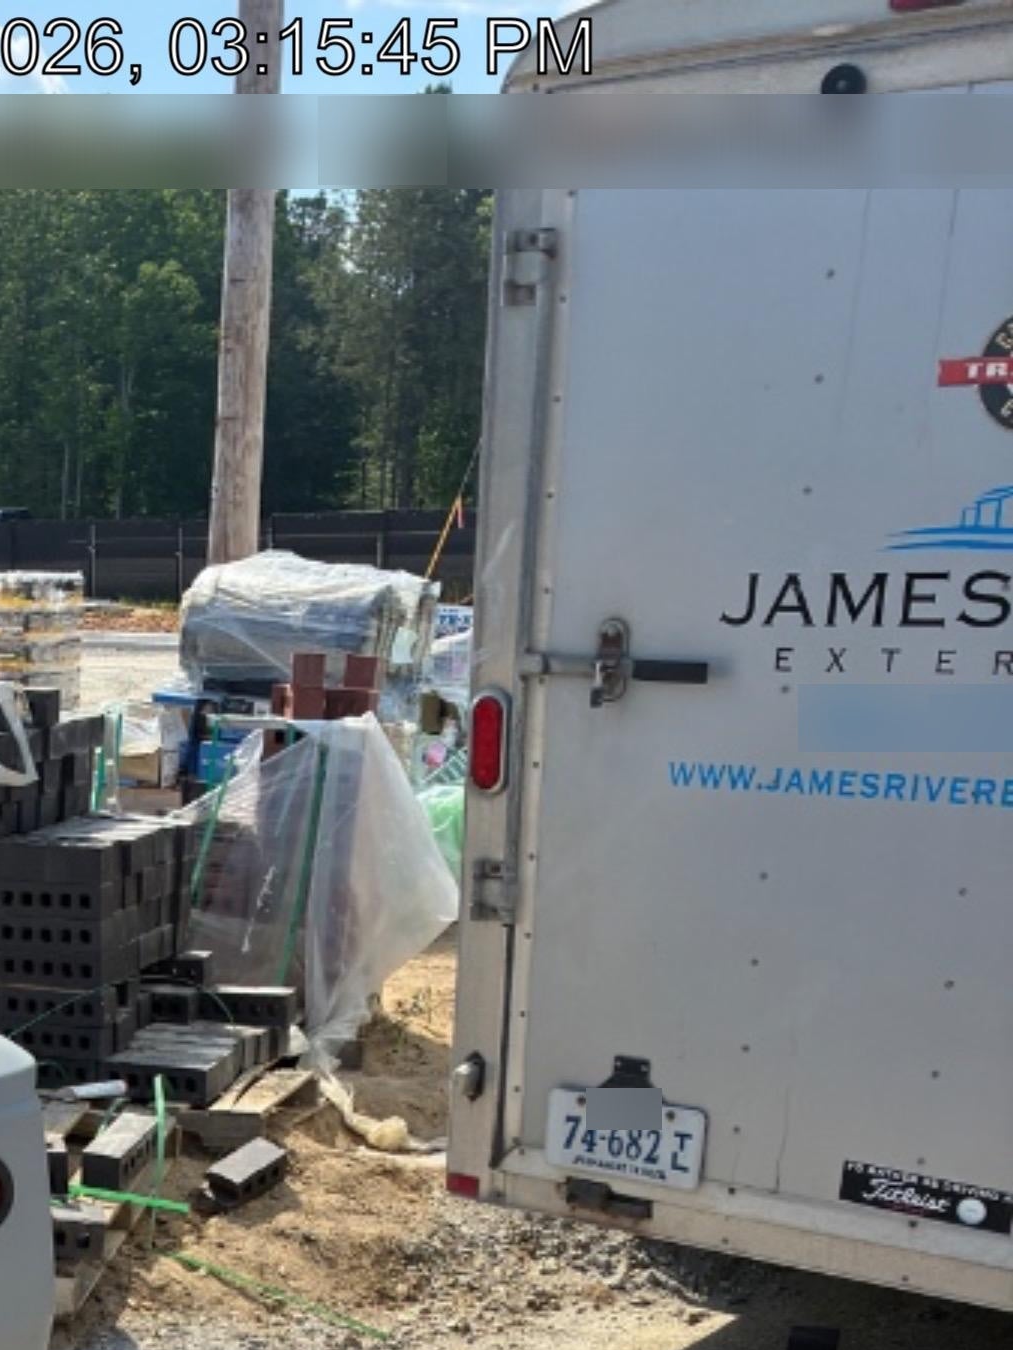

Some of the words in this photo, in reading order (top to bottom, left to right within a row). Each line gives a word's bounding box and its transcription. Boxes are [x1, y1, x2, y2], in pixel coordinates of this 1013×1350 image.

[966, 361, 1013, 380] TR
[718, 570, 1013, 628] JAMES
[774, 647, 1013, 676] EXTER
[563, 1115, 661, 1165] 74-682
